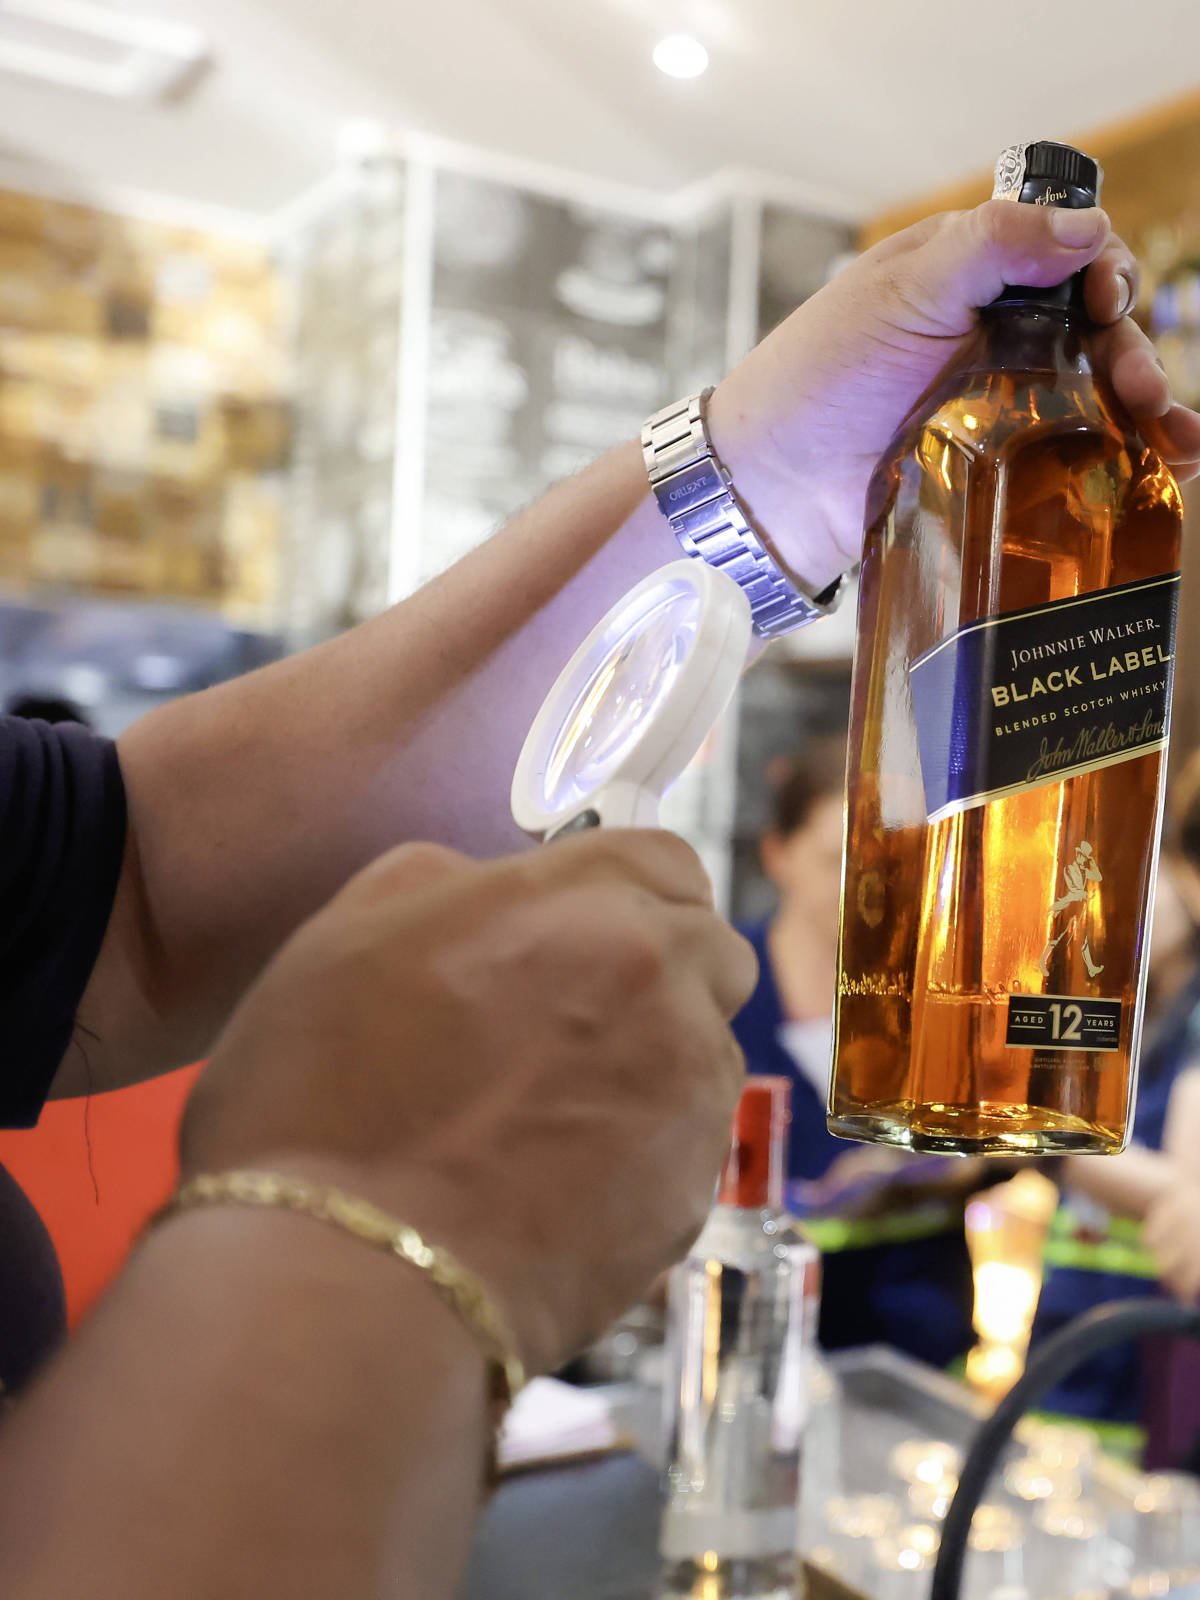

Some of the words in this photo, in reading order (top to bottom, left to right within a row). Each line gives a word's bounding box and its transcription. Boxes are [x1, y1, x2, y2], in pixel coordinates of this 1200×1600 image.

[1042, 185, 1068, 206] Sons
[669, 477, 707, 501] ORIENT
[1011, 634, 1085, 672] JOHNNIE
[1089, 617, 1155, 645] WALKER
[991, 664, 1083, 707] BLACK
[1090, 643, 1175, 681] LABEL
[995, 711, 1057, 736] BLENDED
[1064, 695, 1114, 717] SCOTCH
[1120, 679, 1166, 701] WHISKY
[1025, 736, 1074, 783] John
[1073, 718, 1128, 760] Walker
[1014, 1015, 1044, 1024] AGED
[1048, 1003, 1083, 1041] 12
[1086, 1018, 1115, 1027] YEARS
